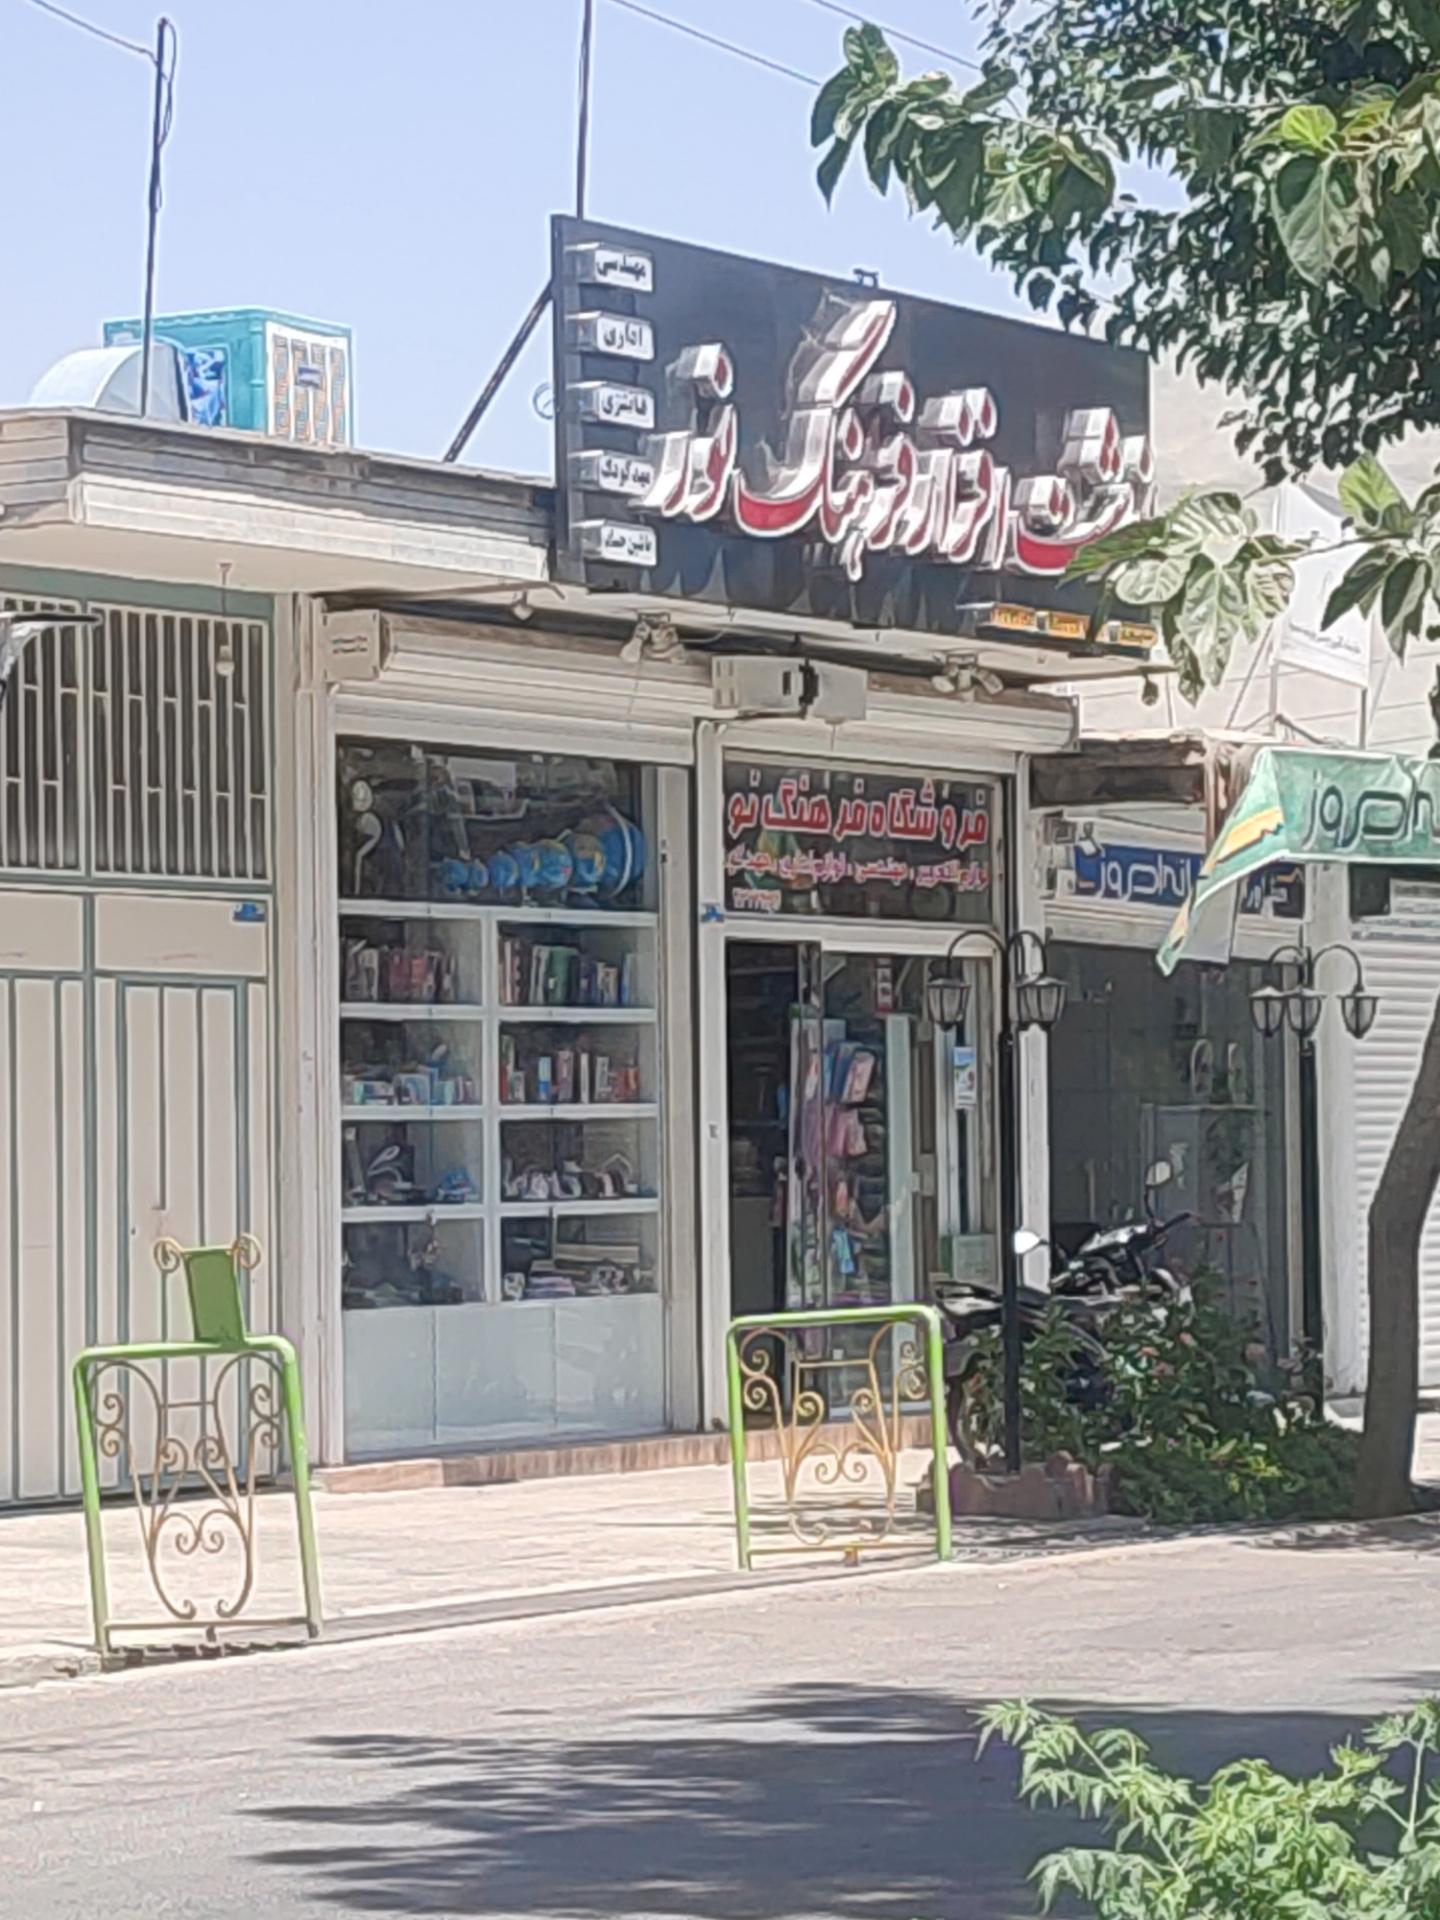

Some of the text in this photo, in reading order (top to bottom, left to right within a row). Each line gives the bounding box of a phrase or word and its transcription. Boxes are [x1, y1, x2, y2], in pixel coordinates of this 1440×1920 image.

[604, 323, 642, 349] اداری
[761, 774, 868, 842] فرهنگ
[869, 777, 988, 851] فروشگاه
